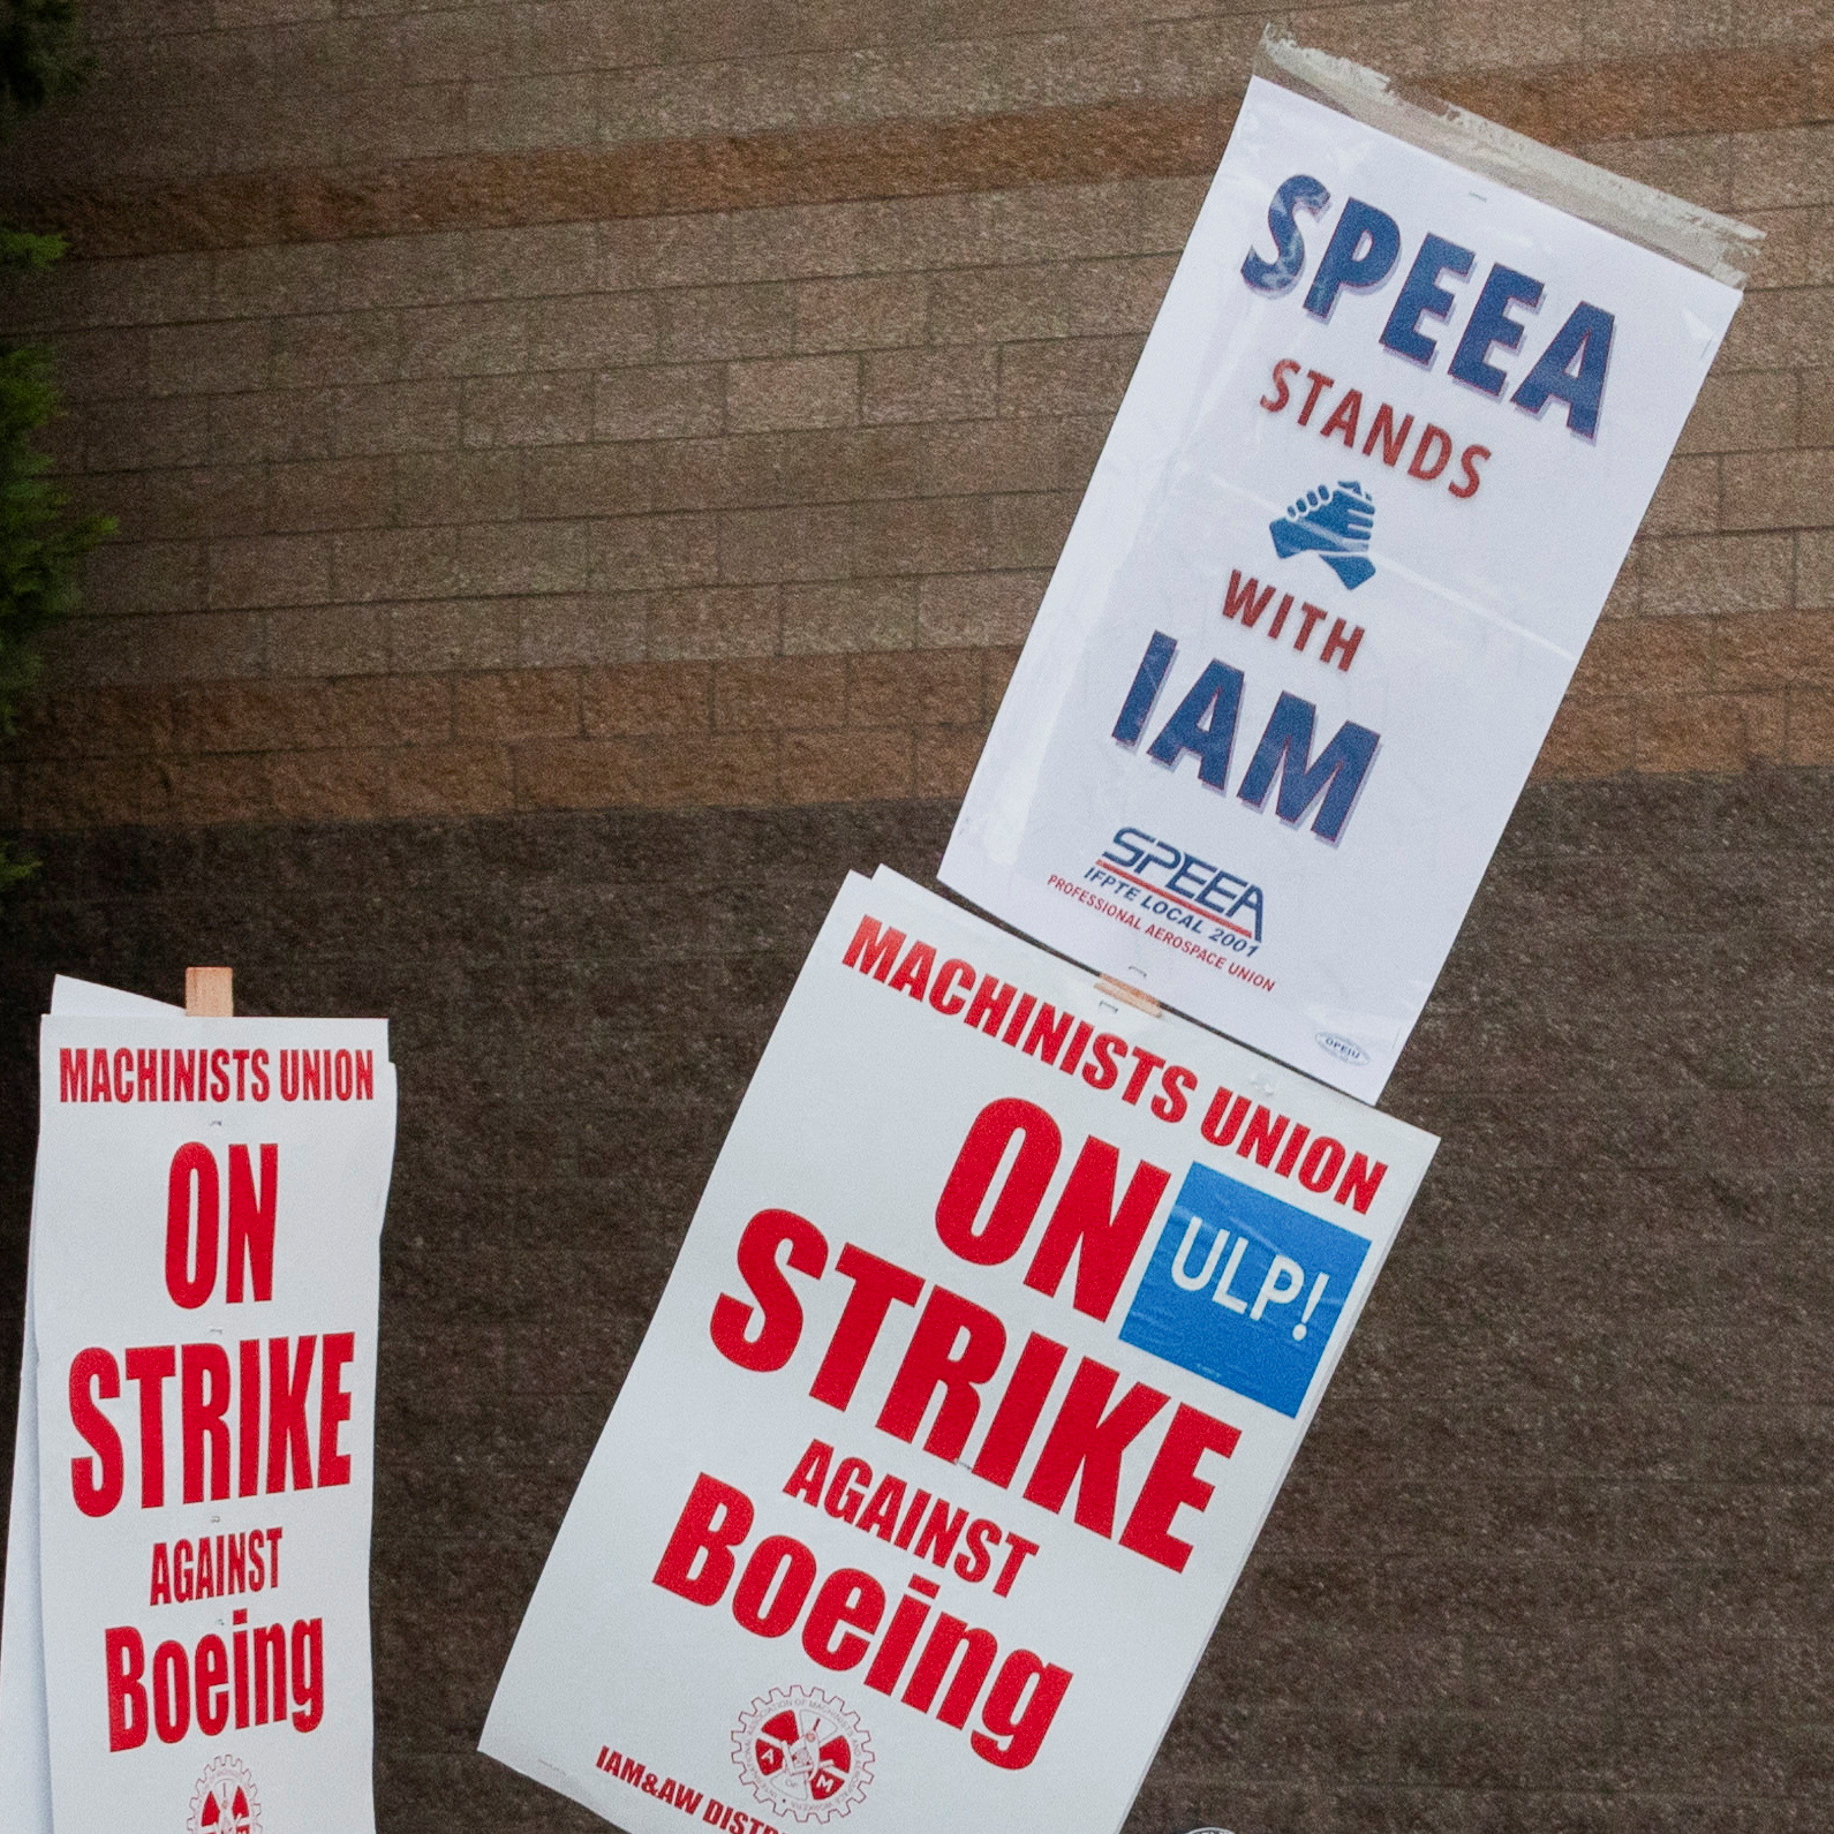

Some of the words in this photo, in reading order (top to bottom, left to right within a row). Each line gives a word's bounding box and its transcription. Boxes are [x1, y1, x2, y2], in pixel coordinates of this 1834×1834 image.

[1242, 175, 1617, 446] SPEEA
[1262, 361, 1489, 498] STANDS
[1224, 571, 1362, 670] WITH
[1112, 629, 1382, 849] IAM
[1047, 875, 1141, 929] PROFESSIONAL
[1145, 924, 1227, 969] AEROSPACE
[1228, 962, 1276, 992] UNION
[1084, 867, 1140, 901] IFPTE
[1140, 895, 1206, 934] LOCAL
[1209, 928, 1259, 958] 2001
[1102, 827, 1264, 942] SPEEA
[59, 1048, 270, 1103] MACHINISTS
[280, 1049, 374, 1101] UNION
[842, 916, 1198, 1123] MACHINISTS
[1201, 1087, 1387, 1214] UNION
[164, 1142, 279, 1310] ON
[935, 1097, 1172, 1322] ON
[1173, 1217, 1331, 1340] ULP!
[68, 1332, 355, 1518] STRIKE
[710, 1208, 1242, 1573] STRIKE
[150, 1527, 283, 1605] AGAINST
[783, 1439, 1039, 1598] AGAINST
[105, 1609, 324, 1752] Boeing
[652, 1473, 1073, 1770] Boeing
[596, 1747, 703, 1814] IAM&AW
